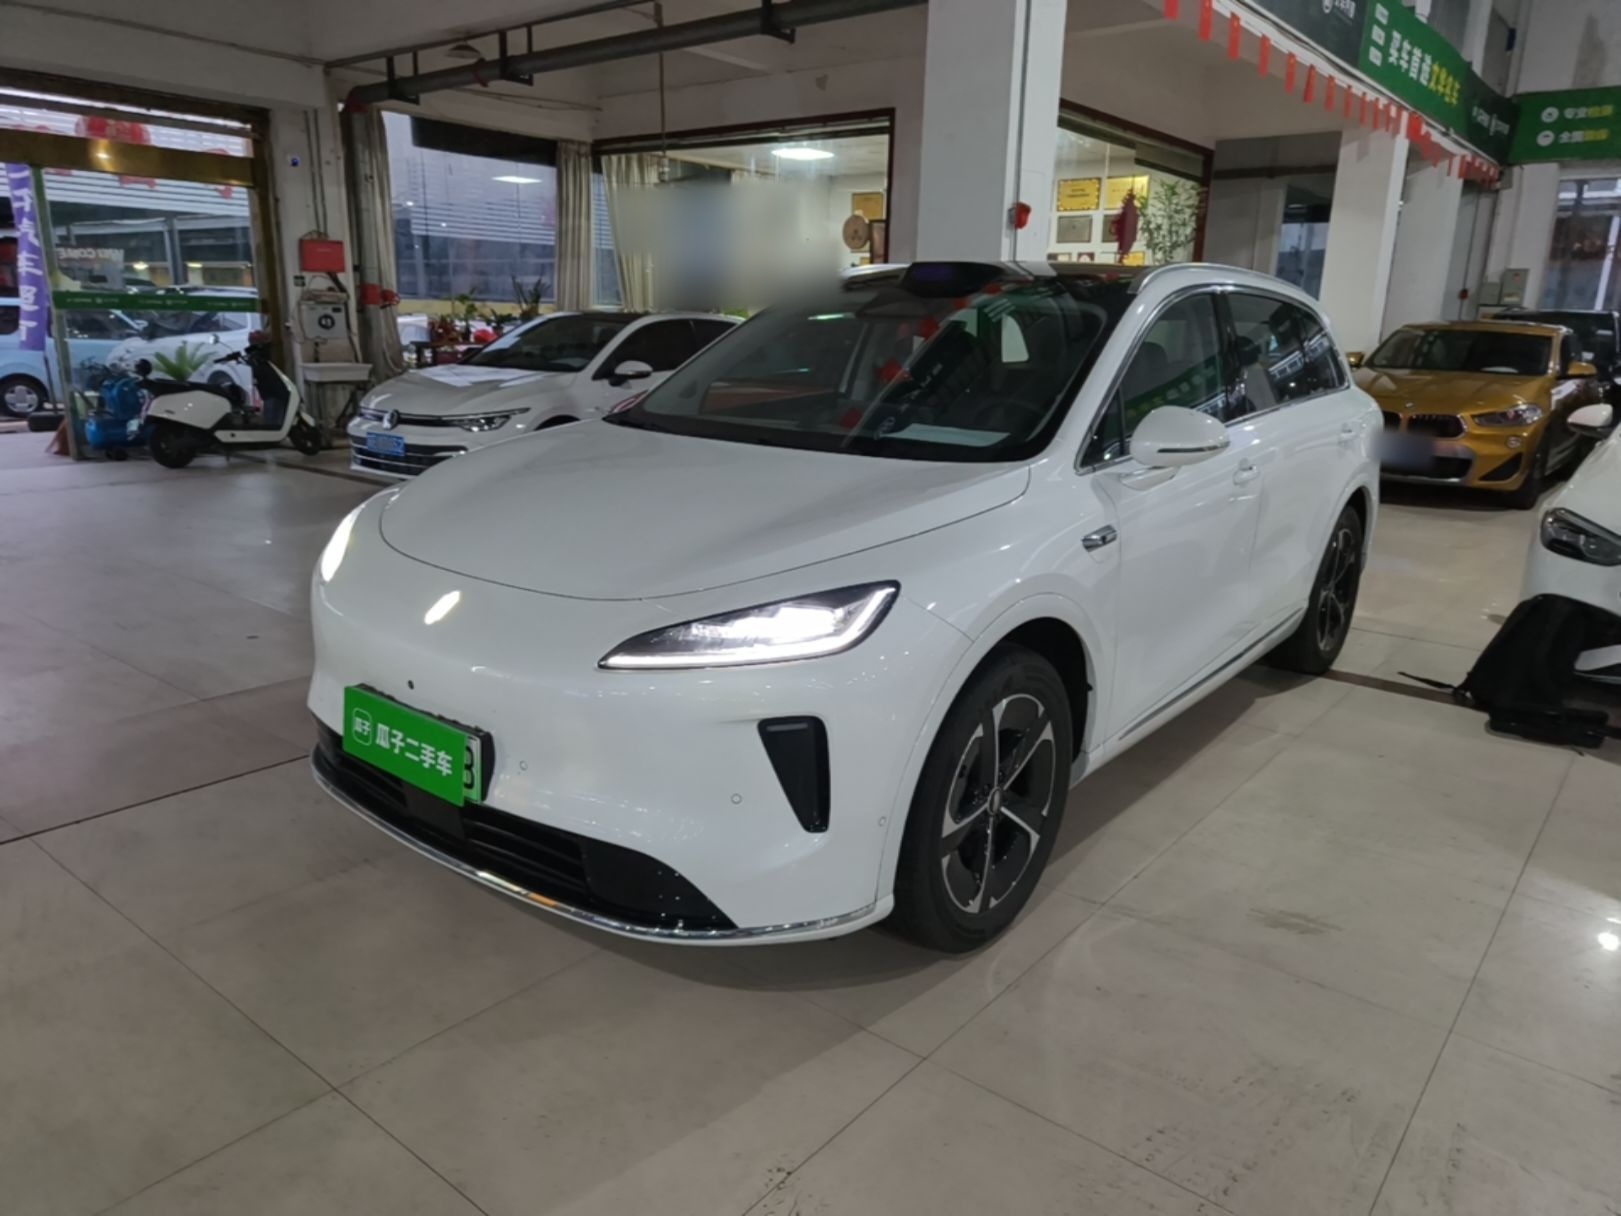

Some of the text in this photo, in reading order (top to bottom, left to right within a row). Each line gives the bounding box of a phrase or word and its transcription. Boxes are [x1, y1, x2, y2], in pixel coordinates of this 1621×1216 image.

[375, 723, 453, 777] 瓜子二手车
